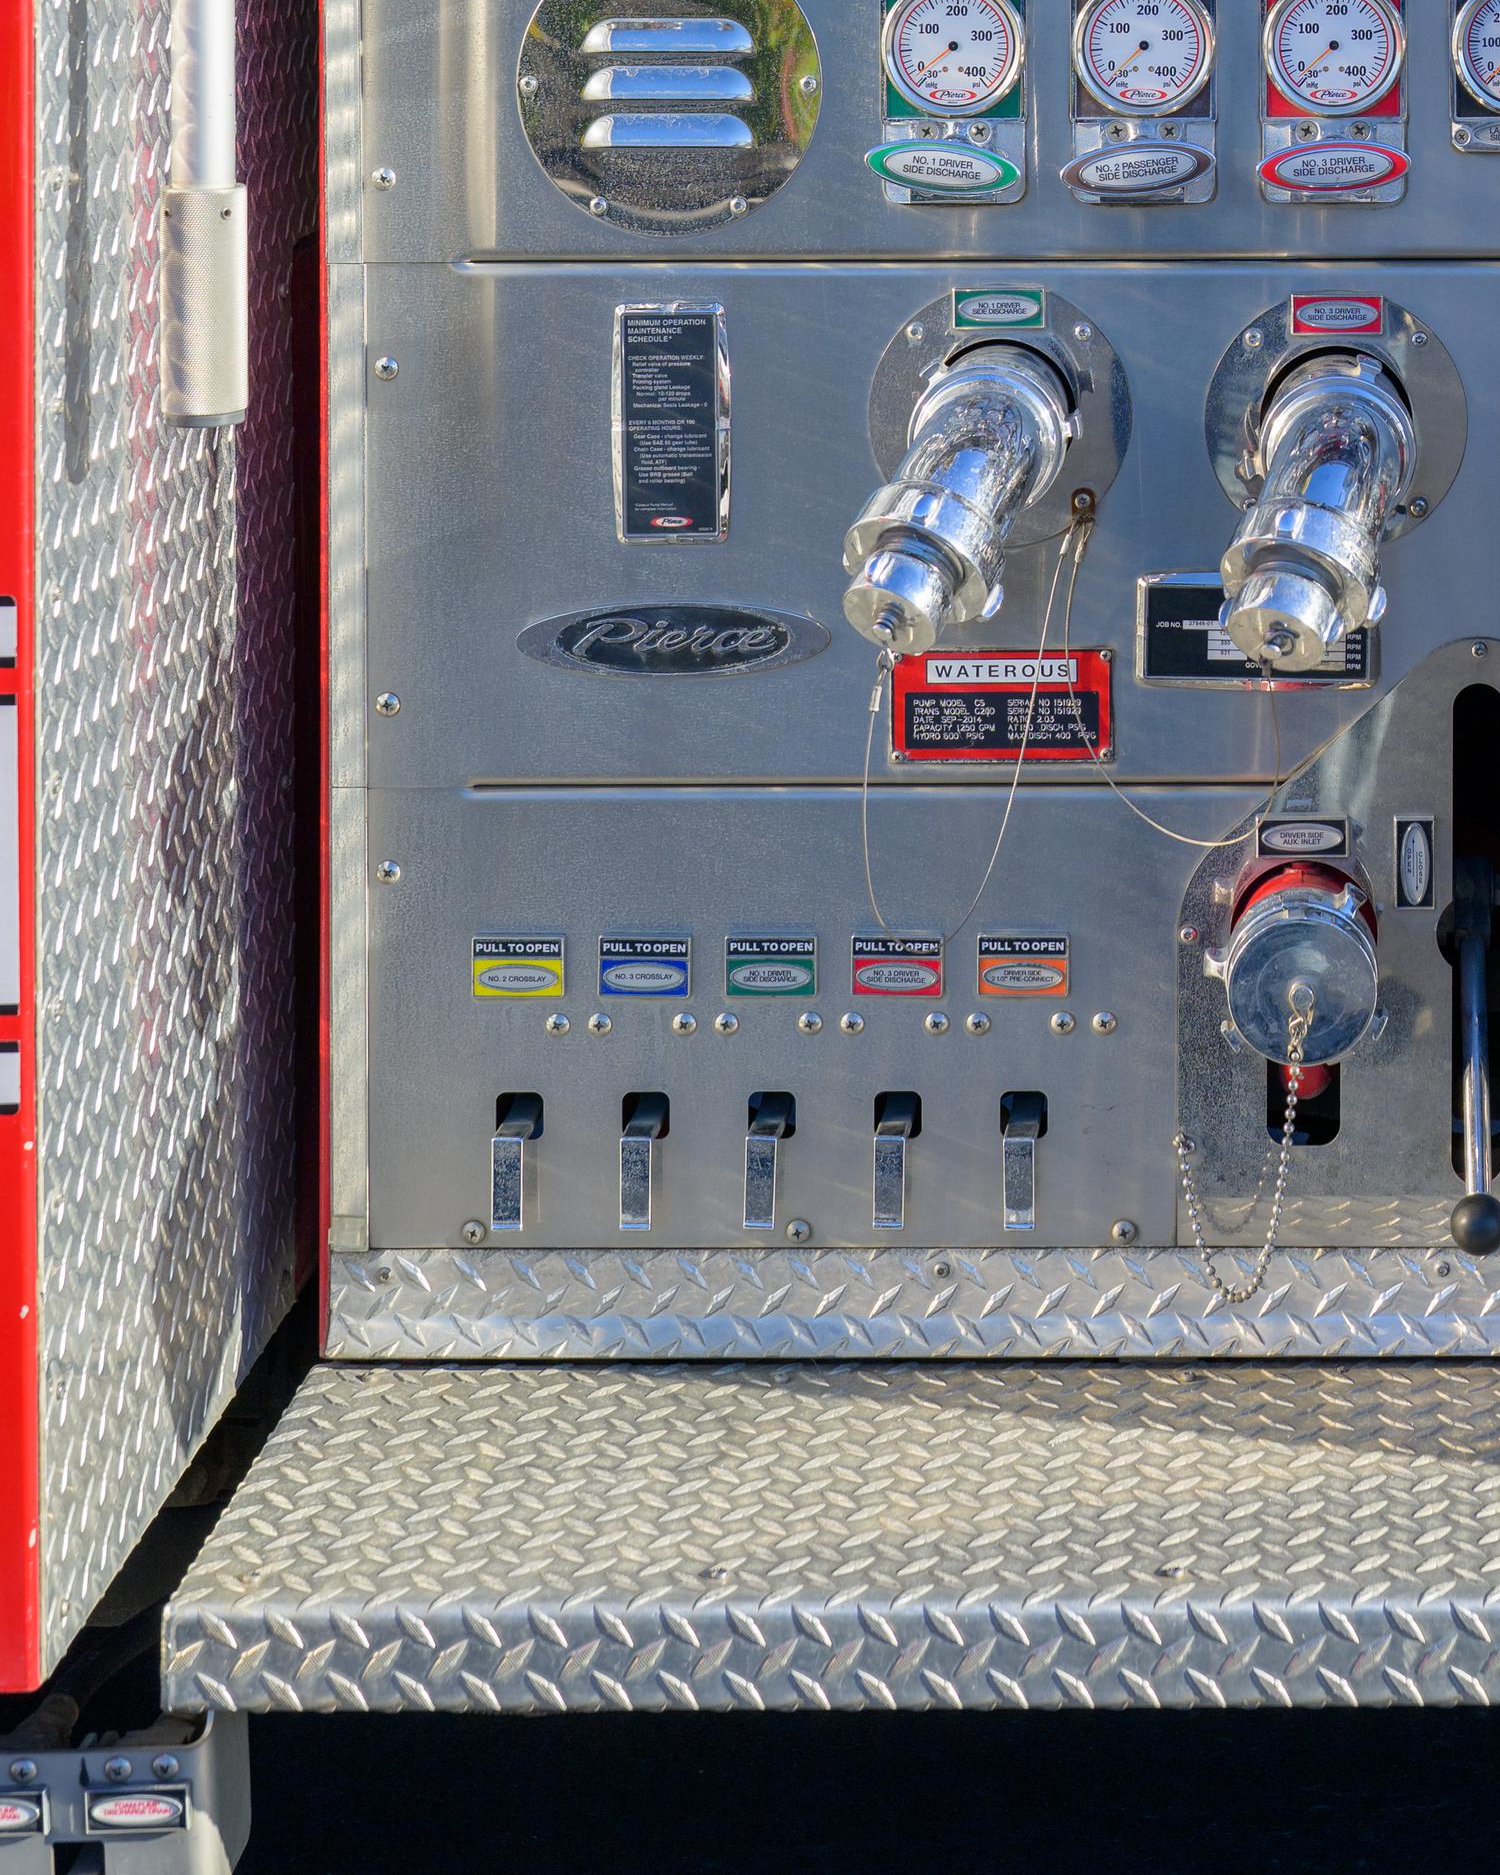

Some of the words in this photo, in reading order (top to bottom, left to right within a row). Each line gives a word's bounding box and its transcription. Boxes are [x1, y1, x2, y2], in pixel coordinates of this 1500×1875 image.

[662, 318, 706, 326] OPERATION
[627, 326, 682, 335] MAINTENANCE
[570, 618, 777, 657] Pierce
[935, 664, 1070, 678] WATEROUS
[1279, 831, 1307, 839] DRIVER
[1307, 831, 1325, 839] SIDE
[475, 943, 505, 953] PULL
[505, 943, 524, 953] TO
[525, 943, 559, 953] OPEN
[488, 975, 501, 983] NO.
